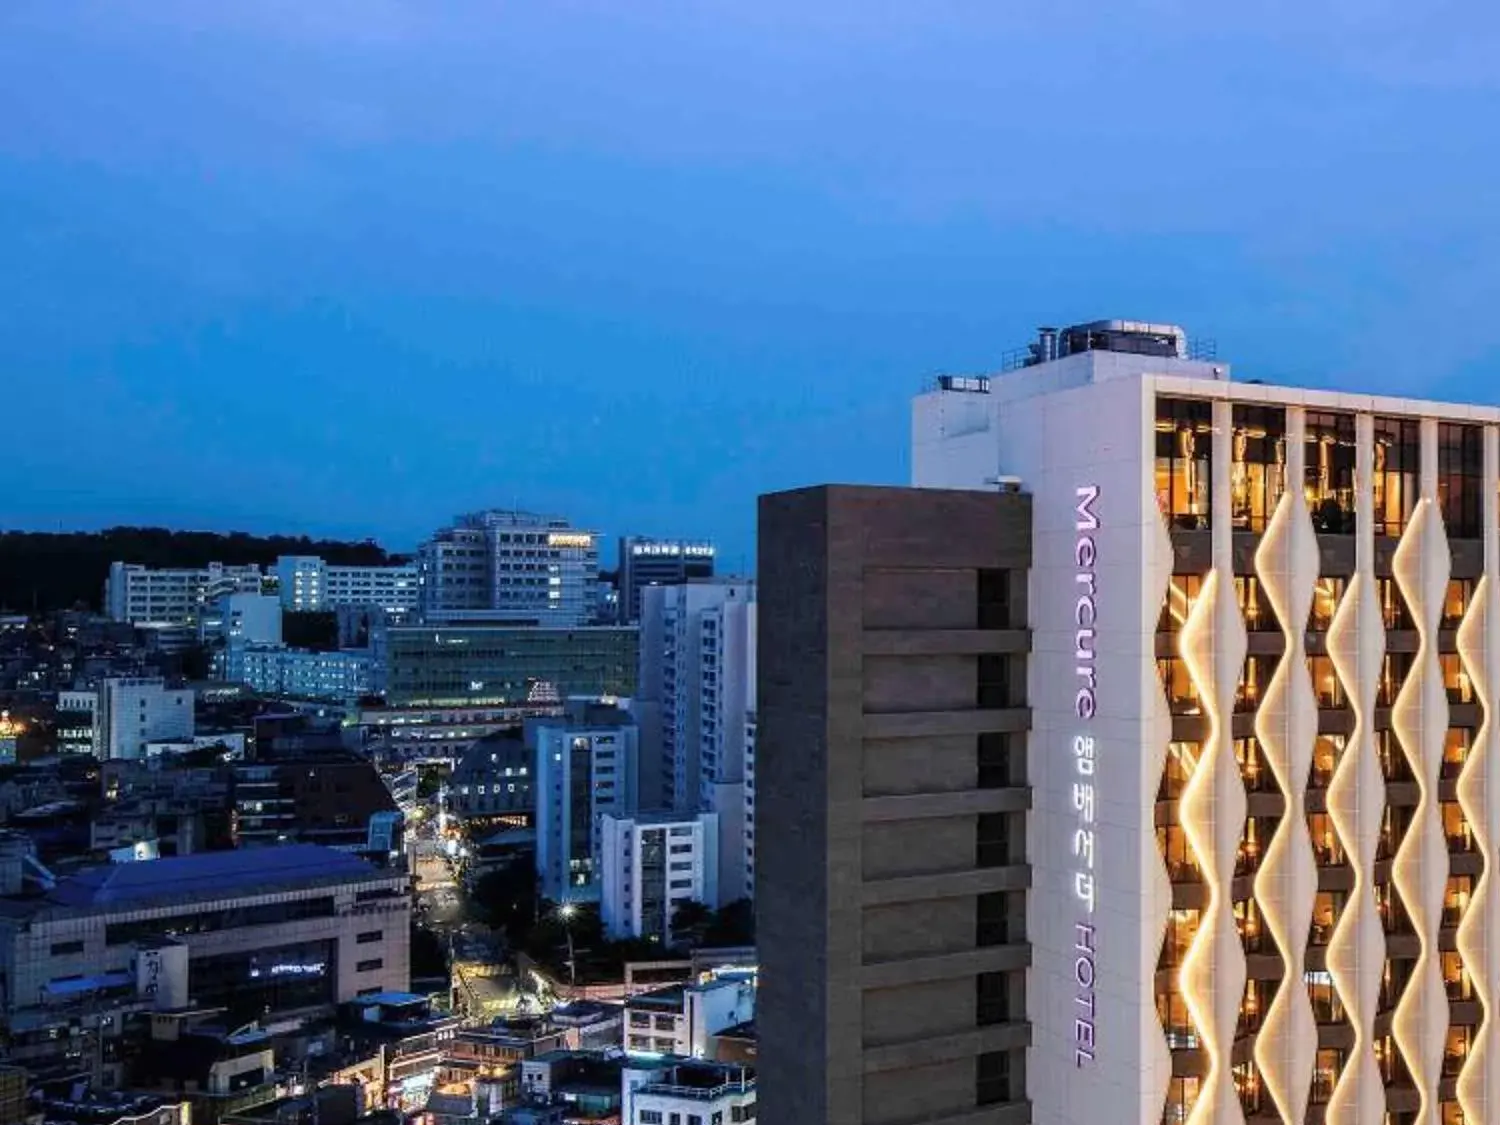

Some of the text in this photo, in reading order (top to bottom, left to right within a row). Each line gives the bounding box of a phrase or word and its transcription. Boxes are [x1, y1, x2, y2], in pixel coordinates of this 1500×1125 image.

[1073, 486, 1100, 1069] Mercure 앰배서더 HOTEL
